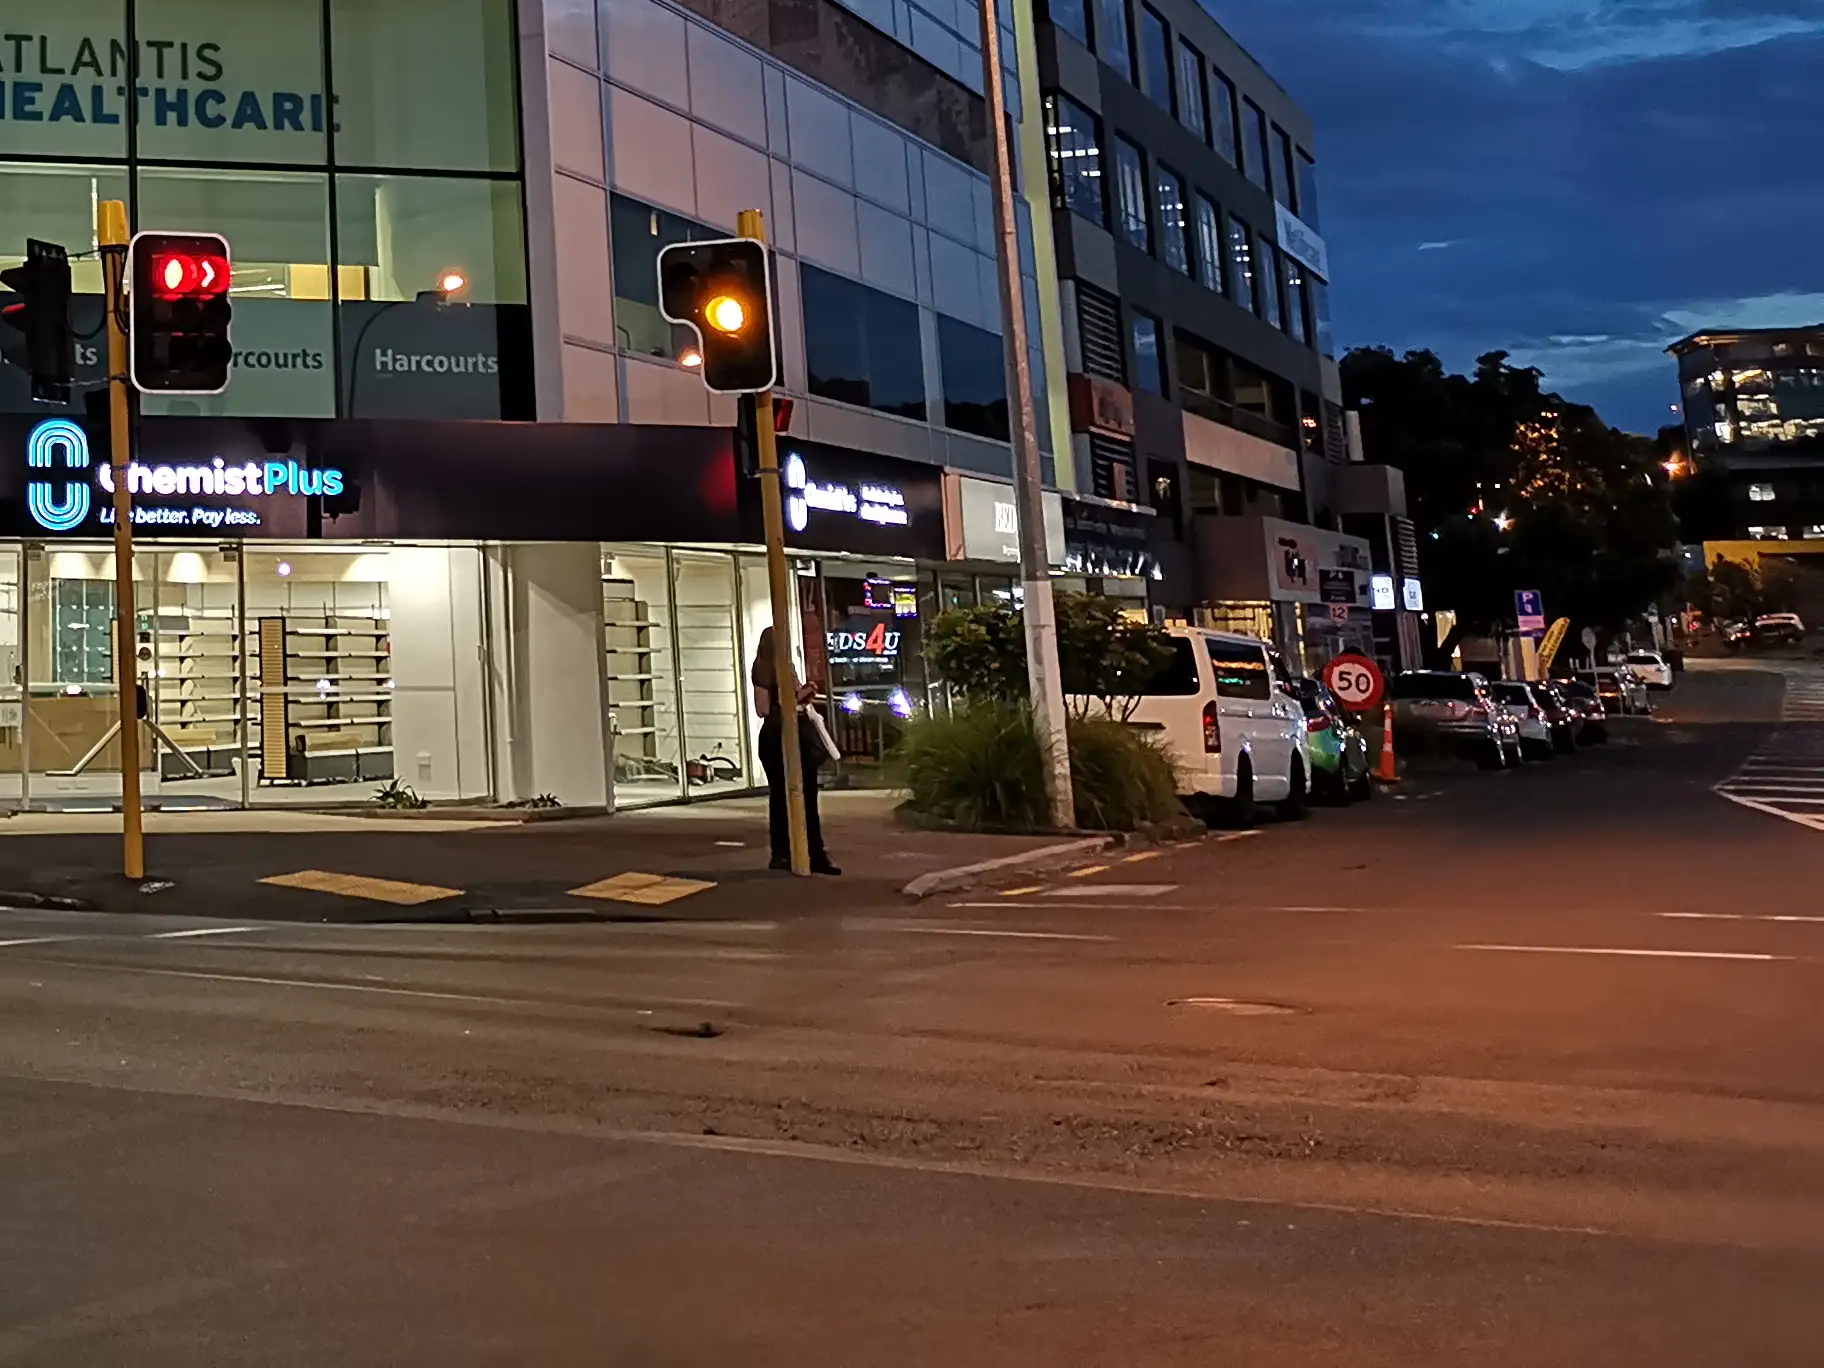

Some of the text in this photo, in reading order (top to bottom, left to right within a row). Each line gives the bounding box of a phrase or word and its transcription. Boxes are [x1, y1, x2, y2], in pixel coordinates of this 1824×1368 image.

[231, 348, 324, 371] rcourts
[374, 338, 499, 374] Harcourts
[99, 458, 345, 497] ChemistPlus
[100, 506, 262, 529] Lie better. Pay less.
[1338, 671, 1371, 694] 50
